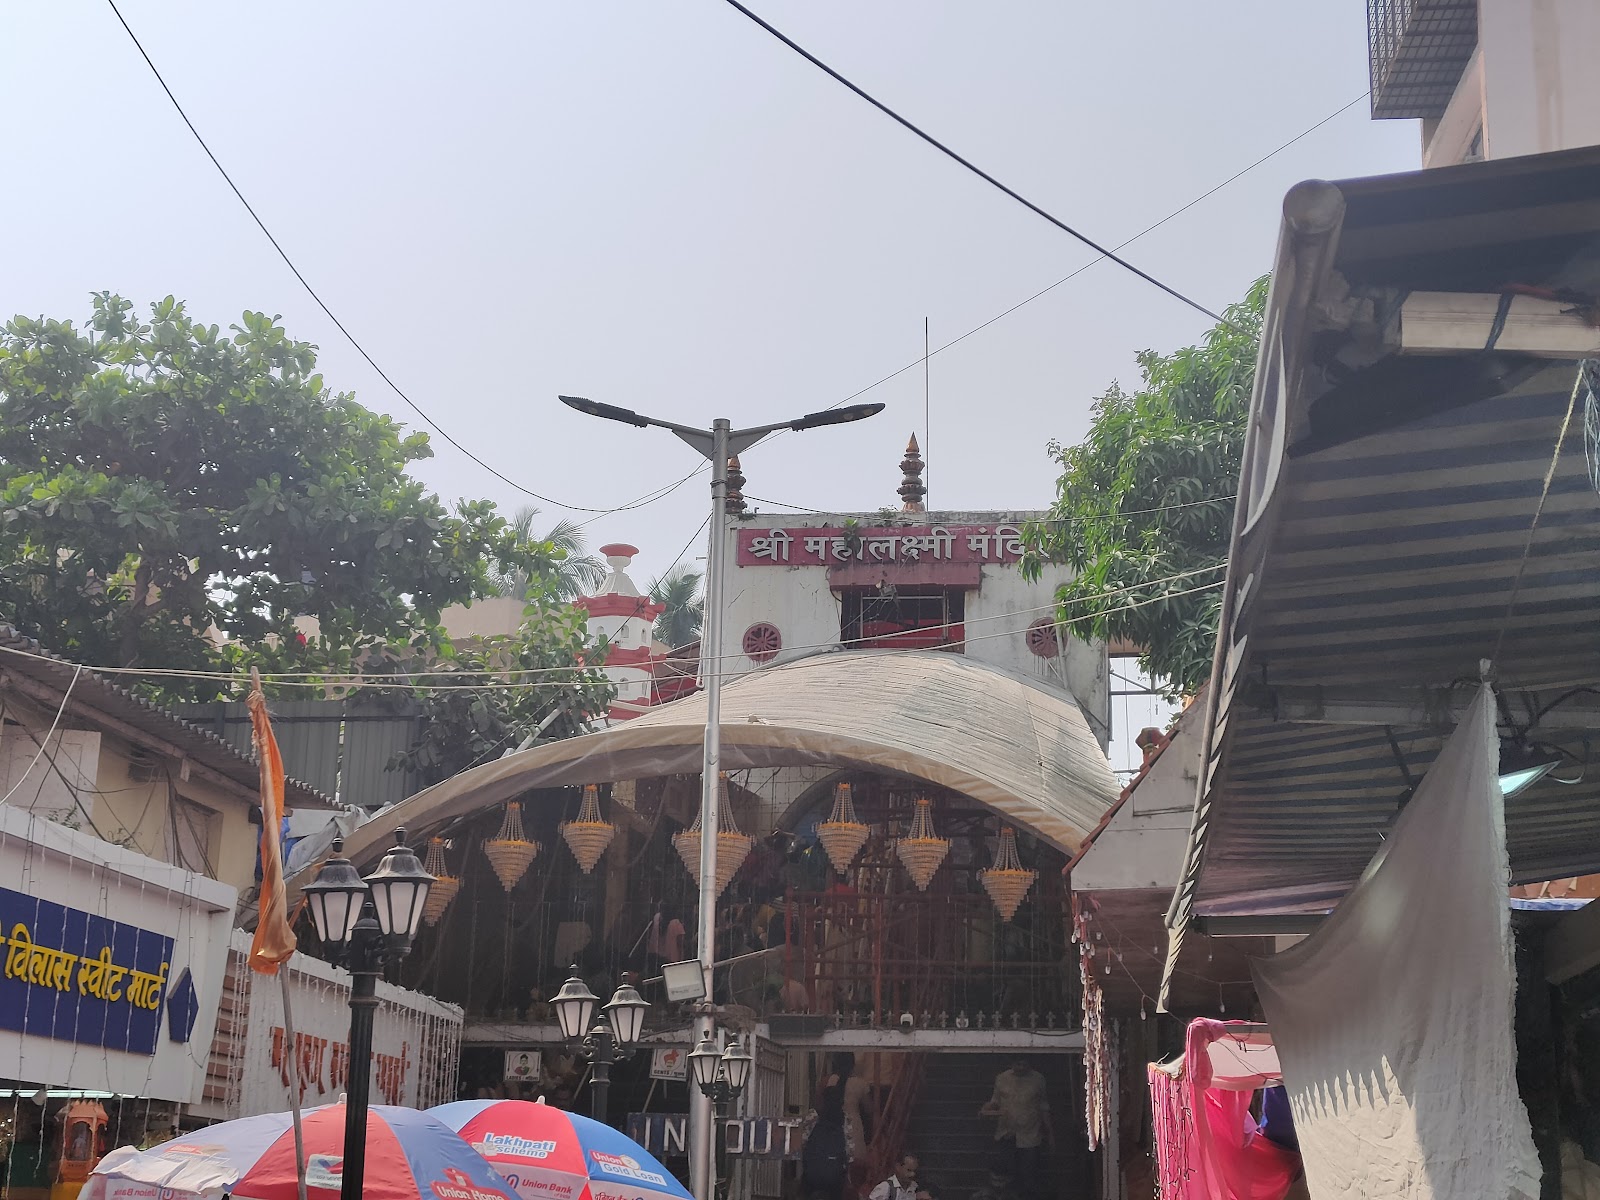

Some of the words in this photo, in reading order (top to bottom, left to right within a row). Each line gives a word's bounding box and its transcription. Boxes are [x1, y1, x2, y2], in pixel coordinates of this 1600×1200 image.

[748, 528, 794, 562] श्री
[5, 922, 79, 992] विलास
[77, 946, 128, 1002] स्वीट
[126, 962, 169, 1010] मार्ट
[484, 1133, 555, 1152] Lakhpati
[645, 1116, 686, 1152] IN
[725, 1118, 800, 1155] OUT
[496, 1145, 546, 1158] scheme
[593, 1151, 622, 1165] Union
[603, 1163, 631, 1176] Gold
[634, 1169, 662, 1183] Loan
[436, 1186, 470, 1200] Union
[470, 1190, 504, 1200] Home
[522, 1179, 548, 1190] Union
[549, 1183, 572, 1194] Bank
